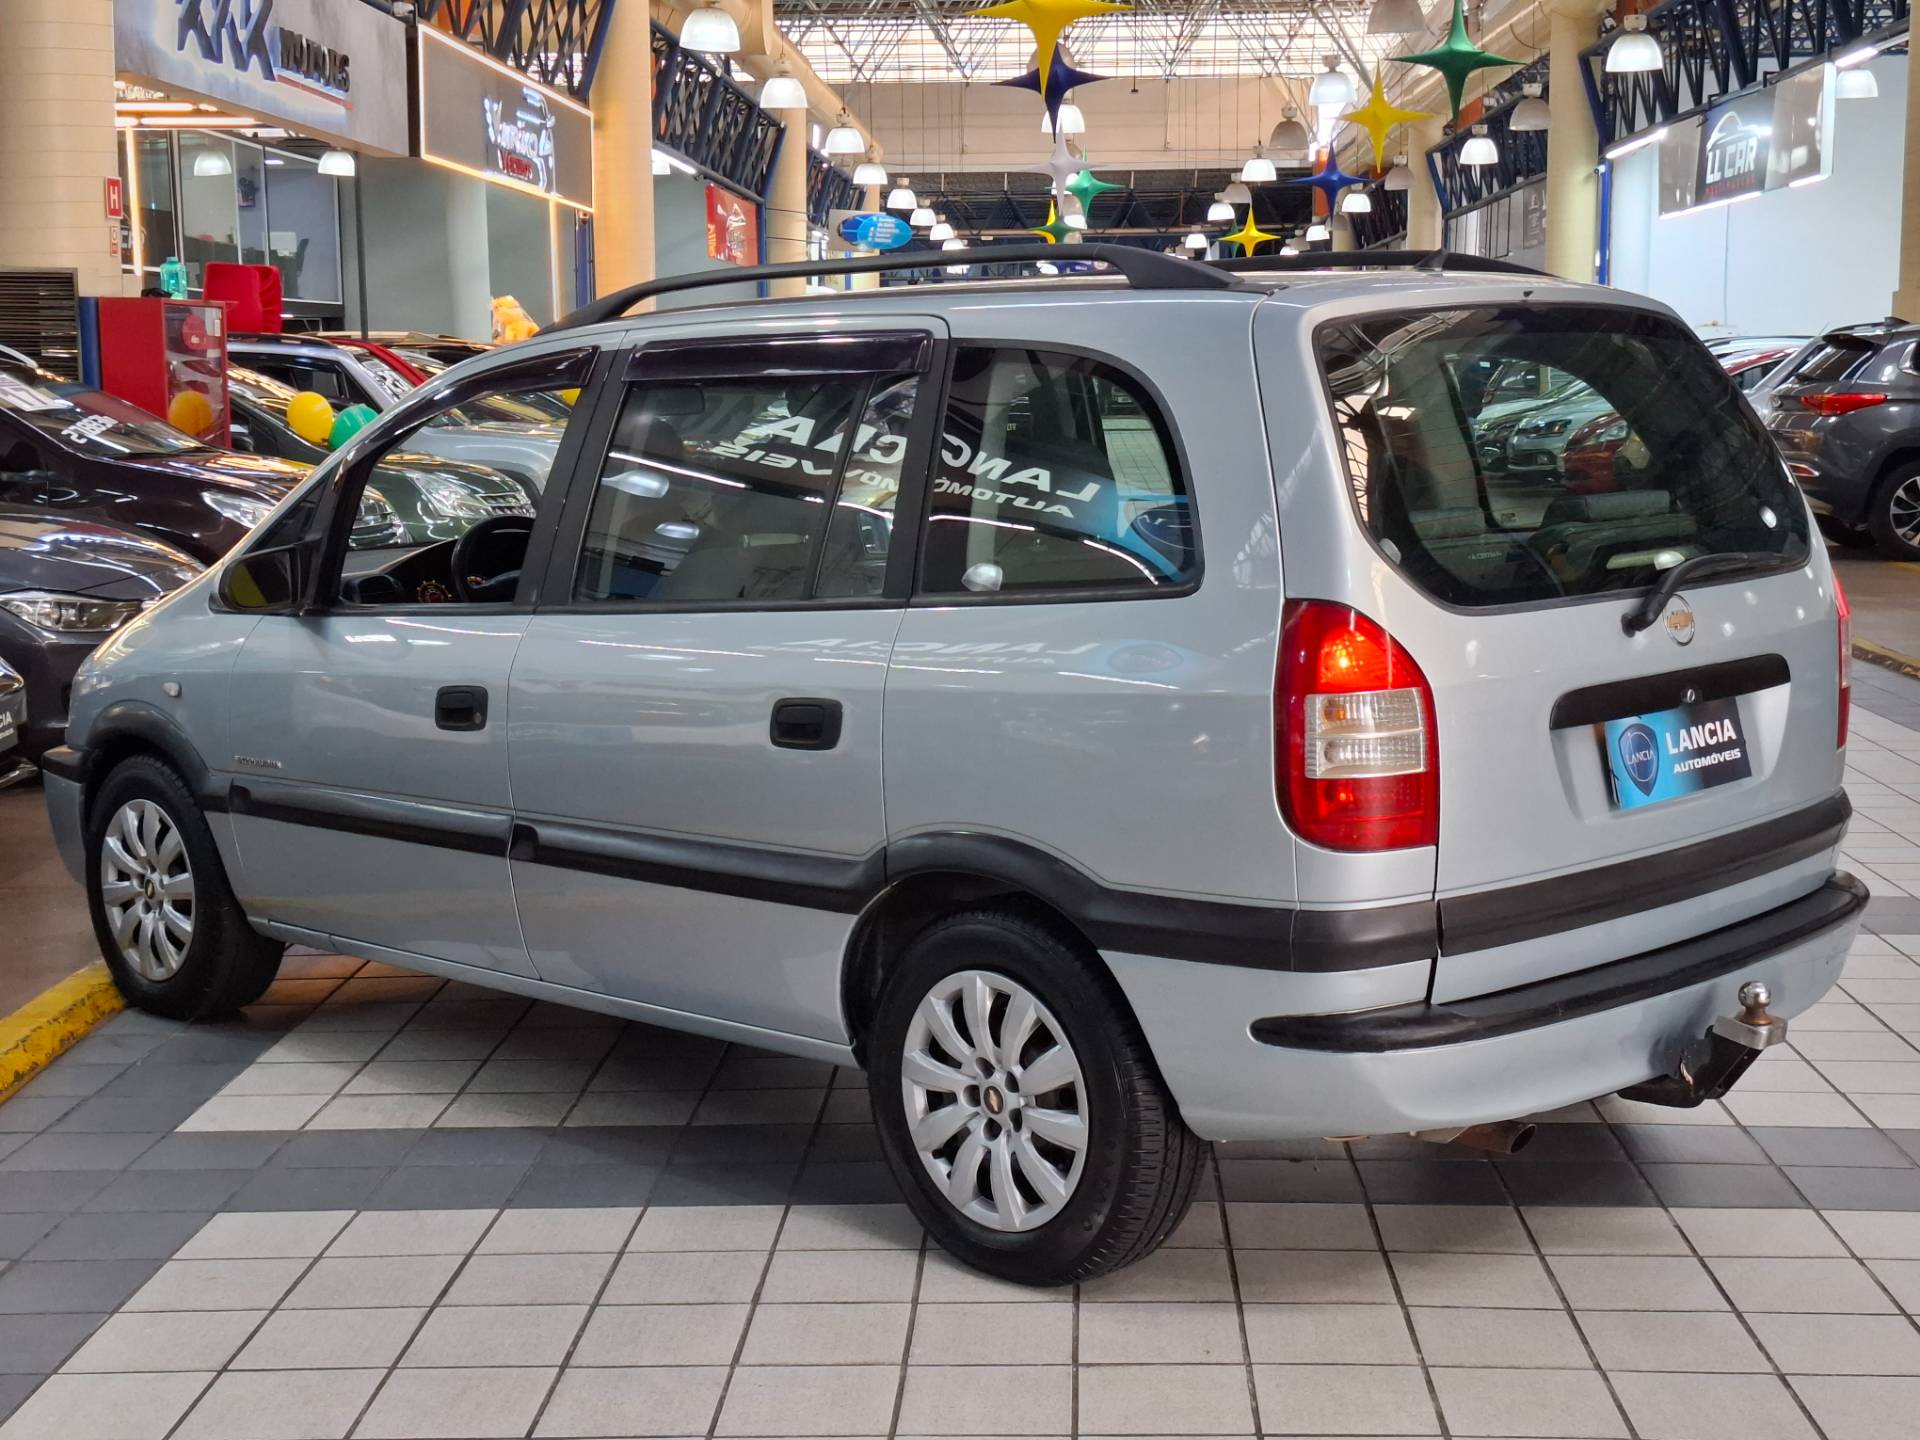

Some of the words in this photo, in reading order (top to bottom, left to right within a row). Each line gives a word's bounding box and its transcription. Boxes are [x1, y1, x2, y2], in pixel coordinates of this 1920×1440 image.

[1724, 136, 1758, 178] CAR
[110, 185, 119, 209] H
[1665, 718, 1737, 755] LANCIA
[1626, 749, 1656, 765] LANCIA
[1673, 748, 1742, 774] AUTOMÓVEIS
